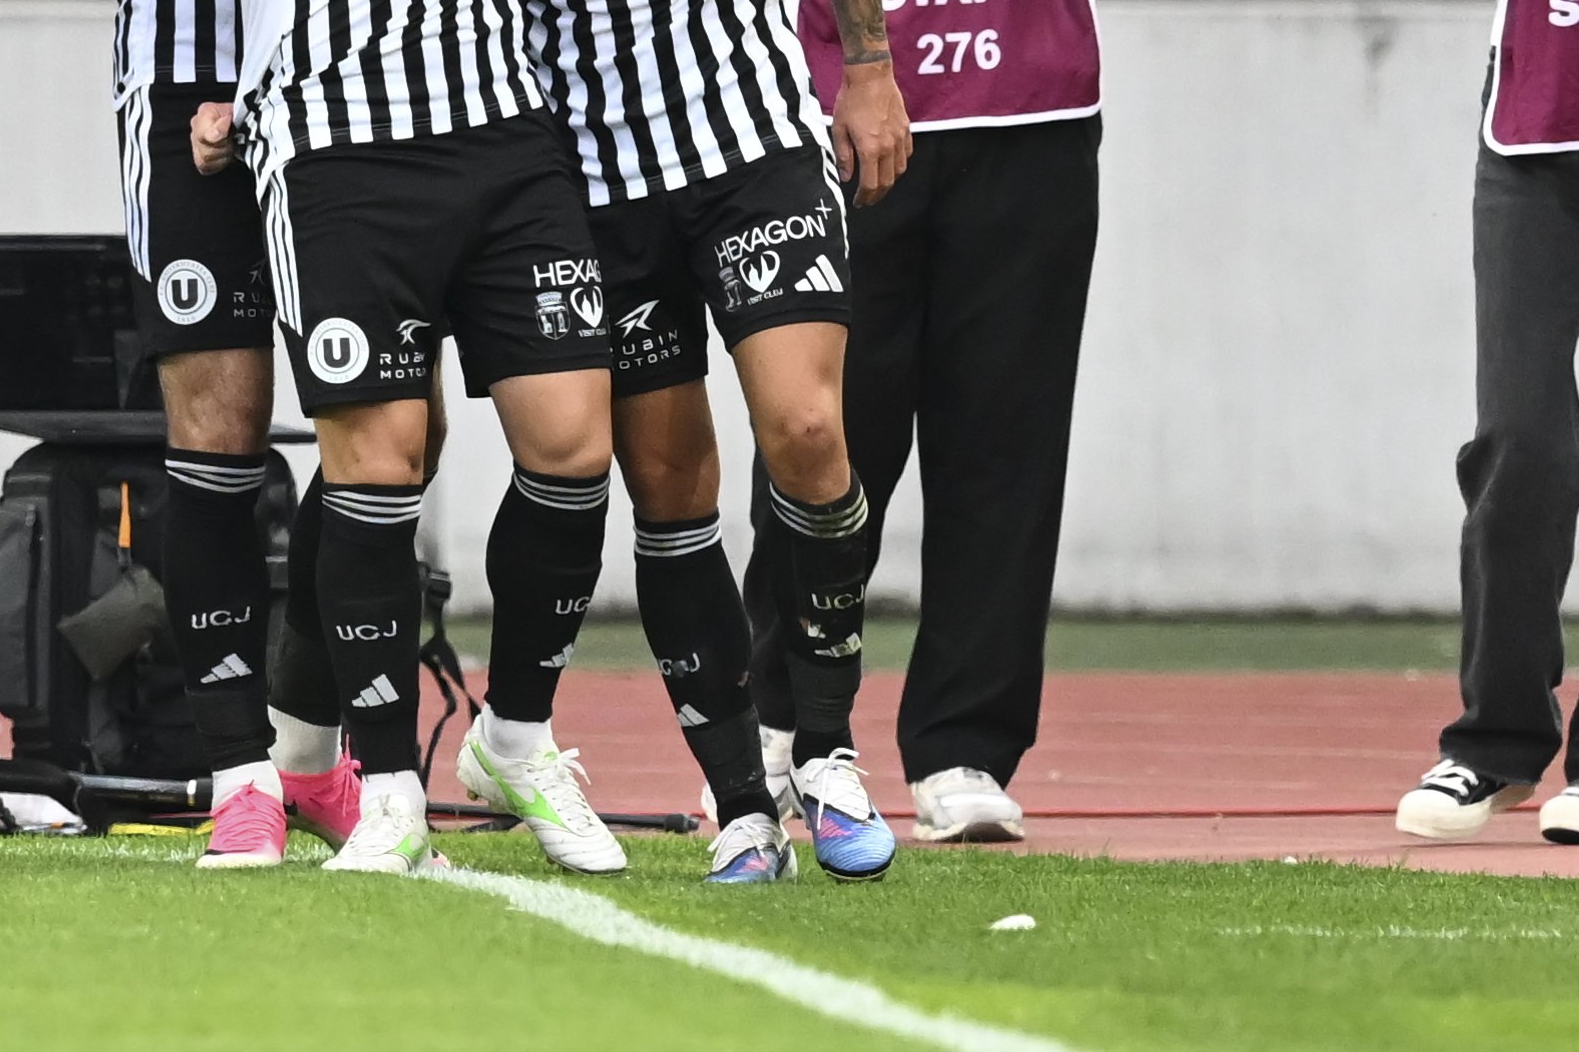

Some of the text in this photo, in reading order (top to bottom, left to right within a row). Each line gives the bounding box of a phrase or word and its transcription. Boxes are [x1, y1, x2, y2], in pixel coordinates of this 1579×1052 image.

[916, 28, 1002, 75] 276
[171, 278, 199, 310] U
[322, 337, 351, 368] U
[610, 329, 678, 355] UBIN
[619, 345, 681, 370] OTORS
